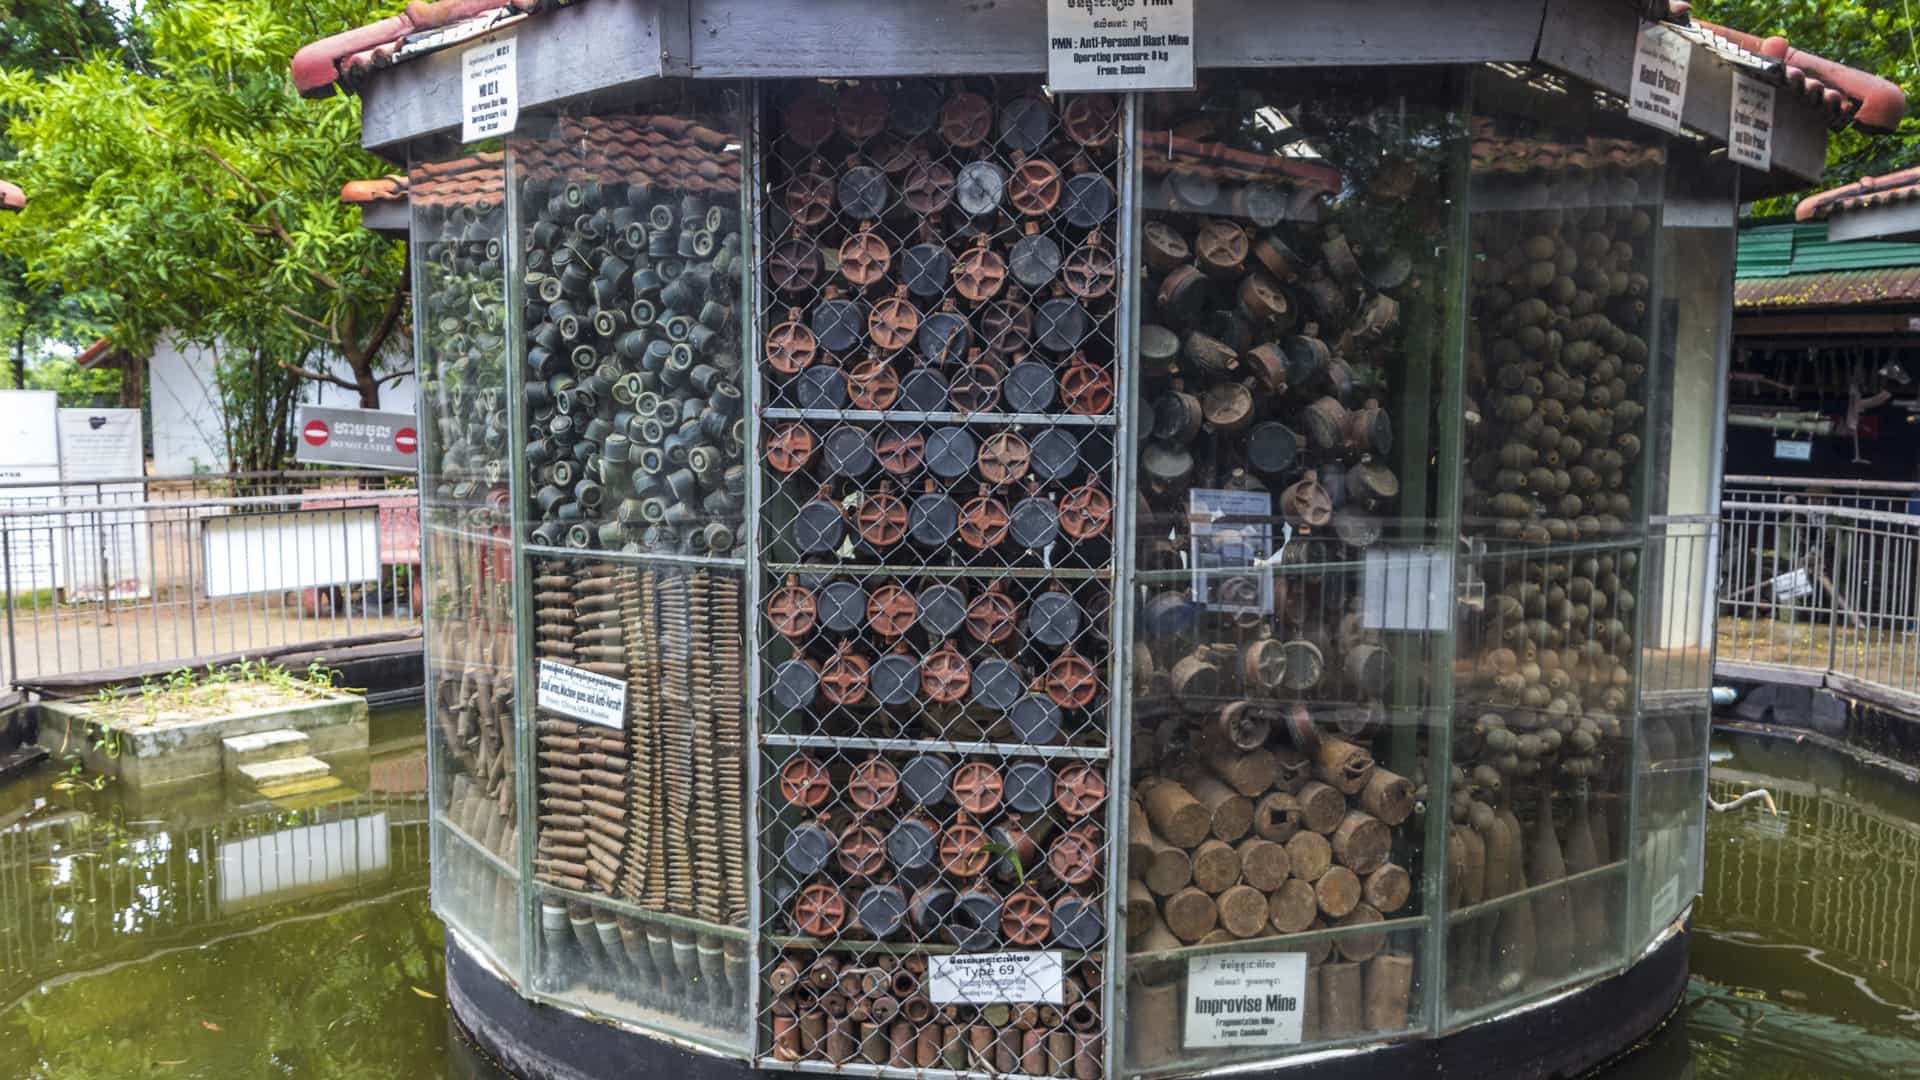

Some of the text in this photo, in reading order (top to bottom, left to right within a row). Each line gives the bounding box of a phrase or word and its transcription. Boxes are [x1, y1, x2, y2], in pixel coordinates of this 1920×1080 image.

[1051, 37, 1072, 49] PMN
[1080, 35, 1140, 48] Anti-Personal
[1143, 35, 1165, 46] Blast
[1168, 34, 1189, 46] Mine
[1073, 52, 1111, 64] Operating
[1158, 50, 1168, 62] kg
[1120, 64, 1145, 75] Russia
[964, 965, 1014, 979] Type 69
[1195, 994, 1296, 1016] Improvise Mine
[1216, 1017, 1260, 1027] Fragmentation
